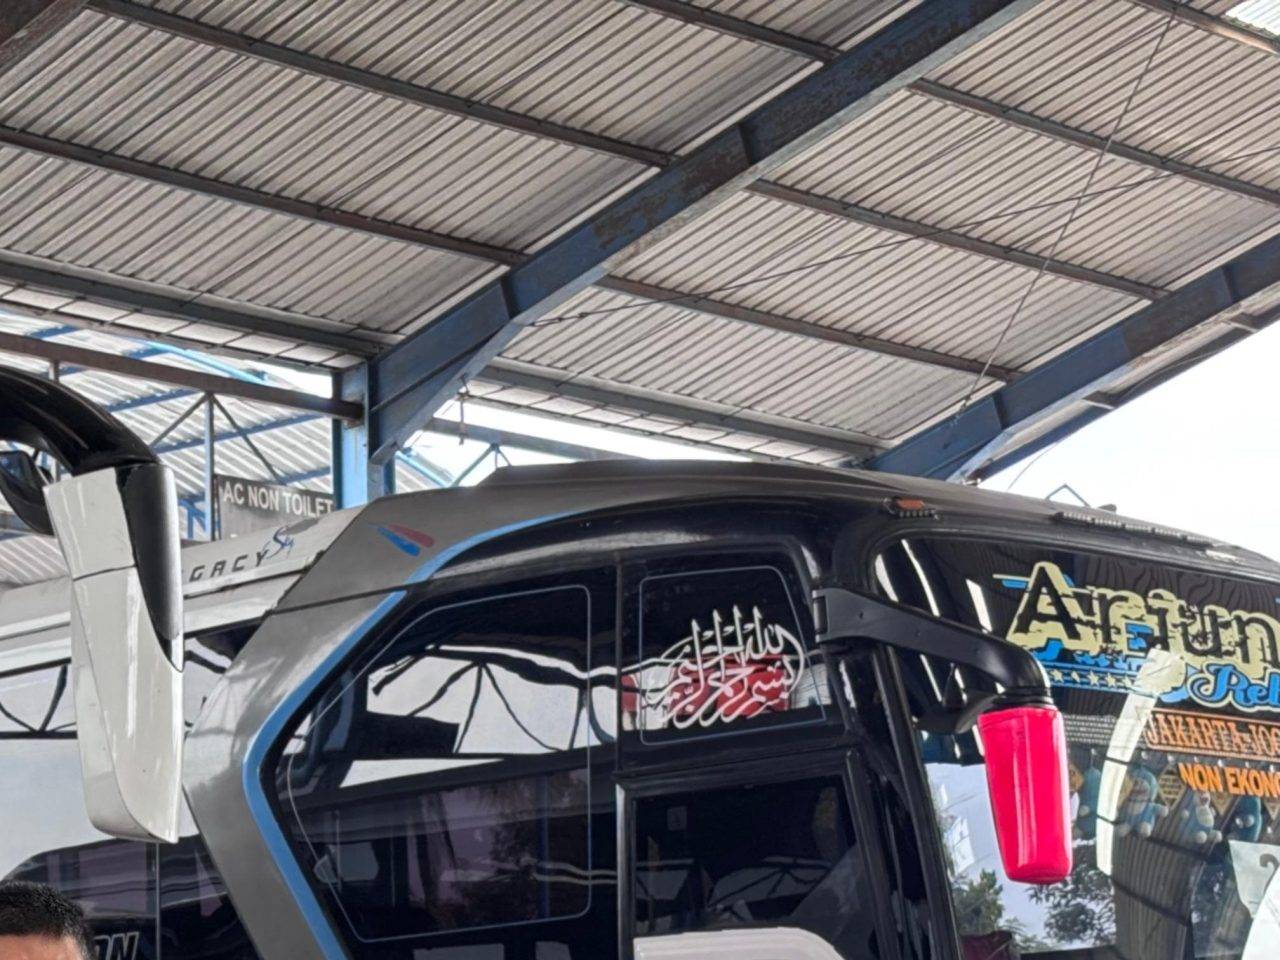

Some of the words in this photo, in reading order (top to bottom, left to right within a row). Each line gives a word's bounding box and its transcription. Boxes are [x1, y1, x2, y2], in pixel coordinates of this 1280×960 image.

[223, 481, 244, 505] AC
[248, 485, 280, 512] NON
[282, 491, 334, 519] TOILET
[188, 550, 269, 583] GACY
[1178, 762, 1224, 794] NON
